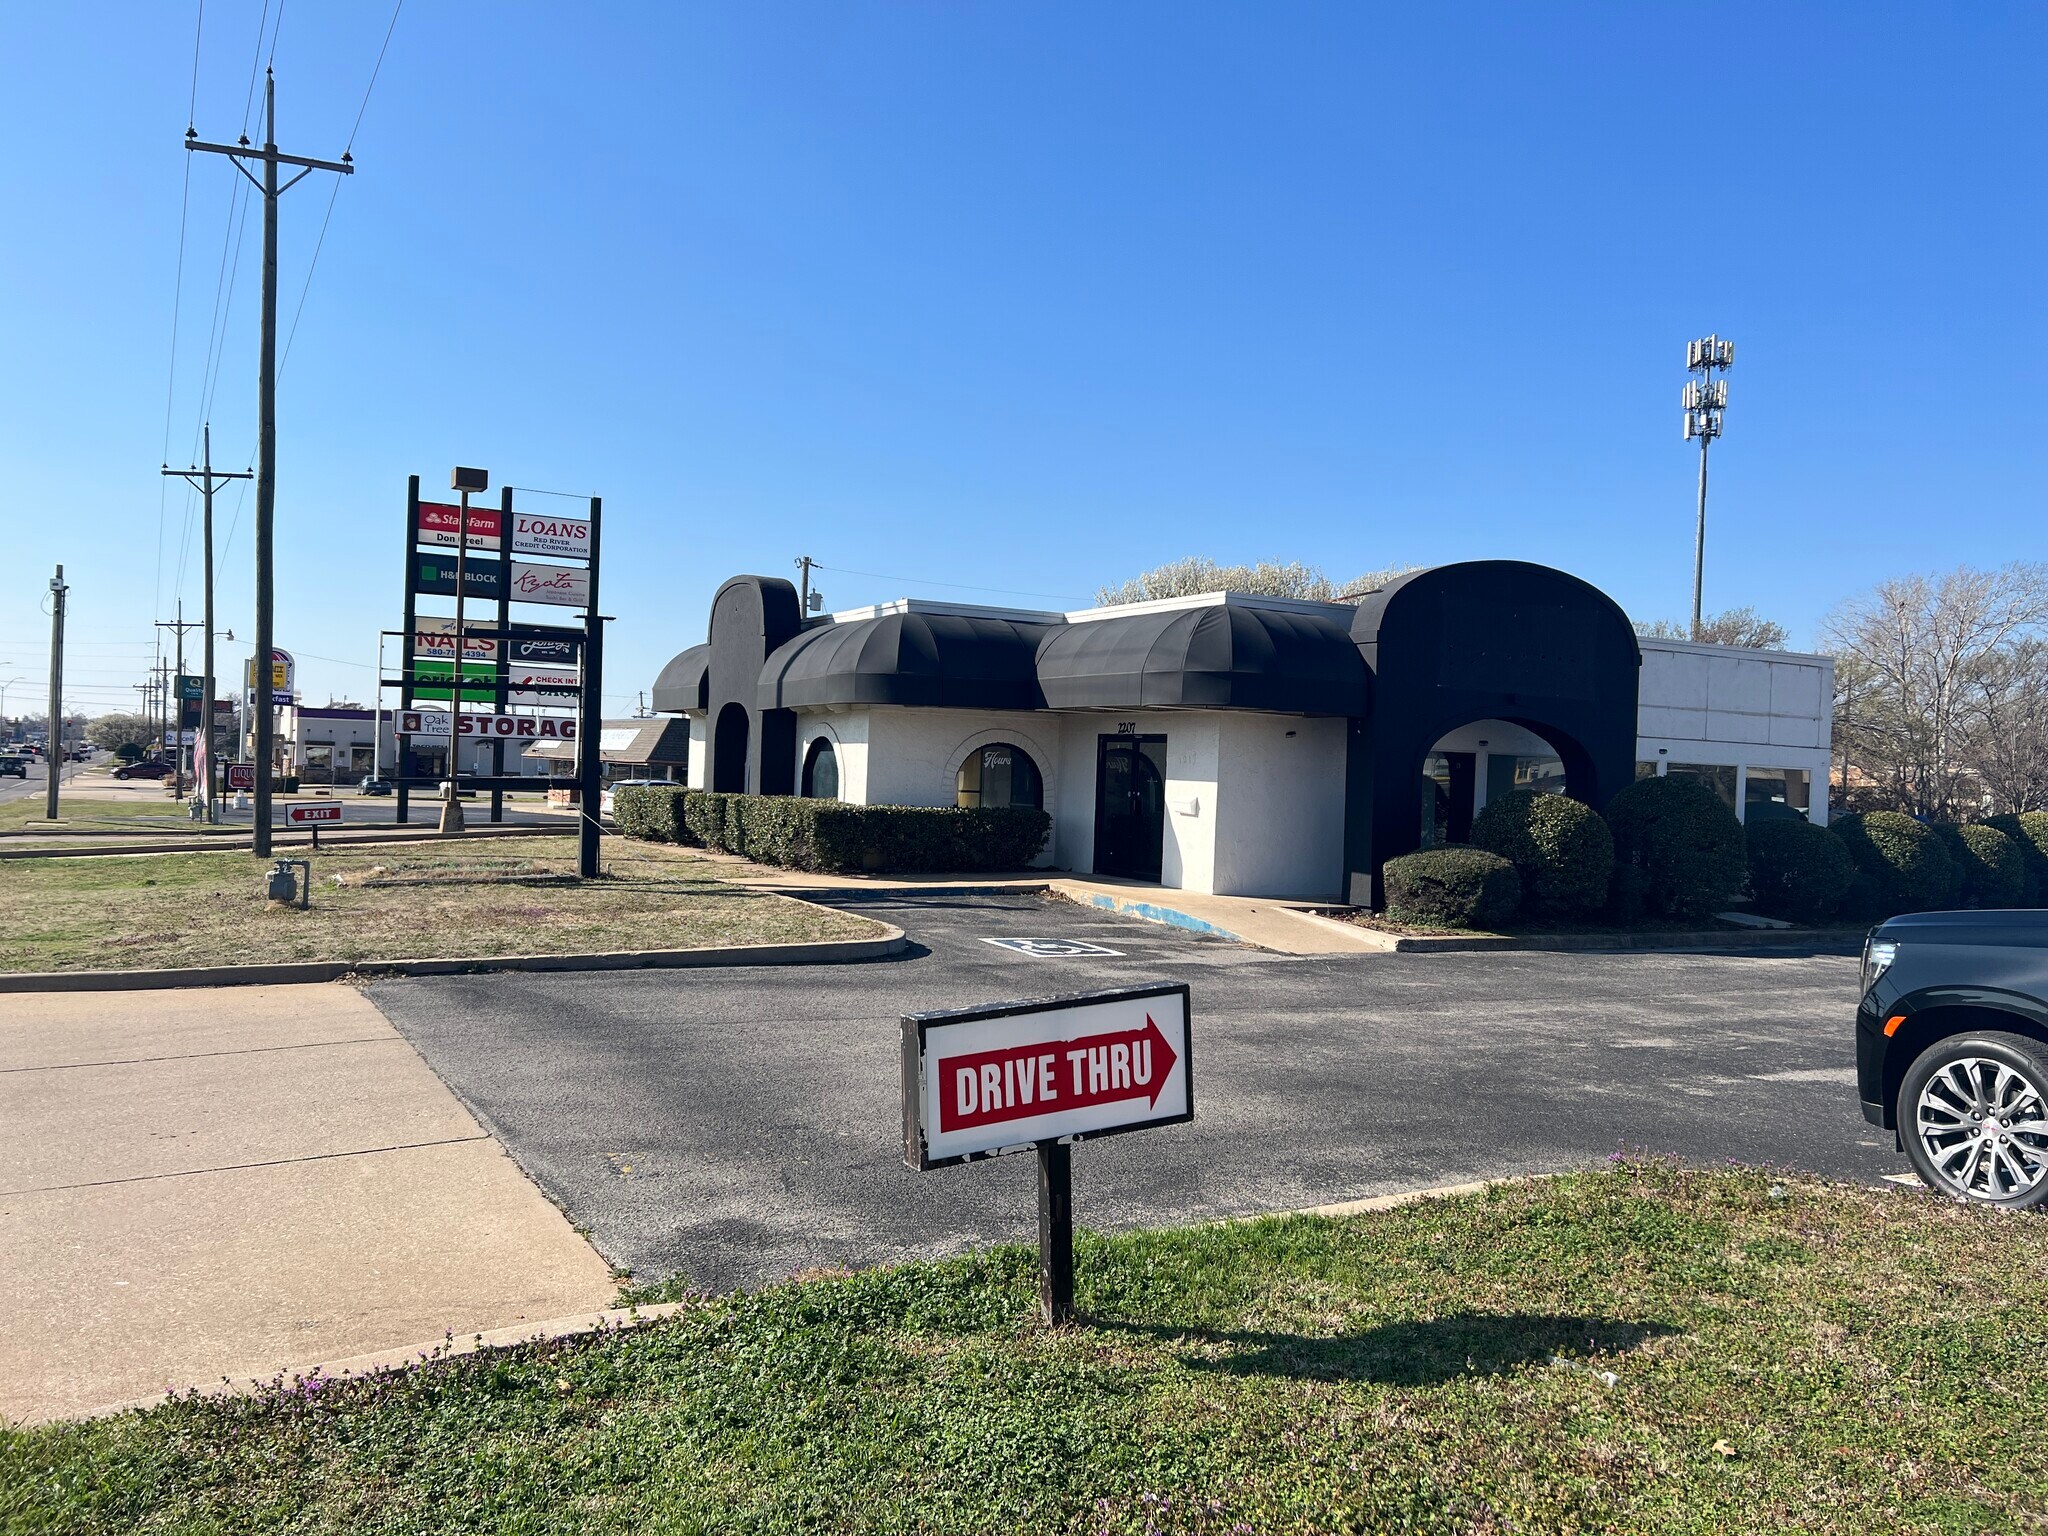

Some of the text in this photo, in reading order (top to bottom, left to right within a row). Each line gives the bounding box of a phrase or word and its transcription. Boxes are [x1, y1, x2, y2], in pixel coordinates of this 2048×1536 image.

[442, 514, 495, 528] StaFarm
[517, 519, 587, 539] LOANS
[437, 533, 483, 545] Don reel
[549, 538, 570, 546] RIVER
[515, 541, 588, 553] CREDIT CORPORATION
[440, 570, 497, 583] H& BLOCK
[417, 631, 495, 651] NALS
[426, 648, 486, 658] 580-78-4394
[536, 676, 563, 684] CHECK
[424, 715, 577, 738] Oak STORAG
[424, 724, 450, 734] Tree
[1117, 722, 1136, 734] 2207
[983, 751, 1012, 770] Hours
[304, 809, 332, 819] EXIT
[956, 1039, 1152, 1116] DRIVE THRU
